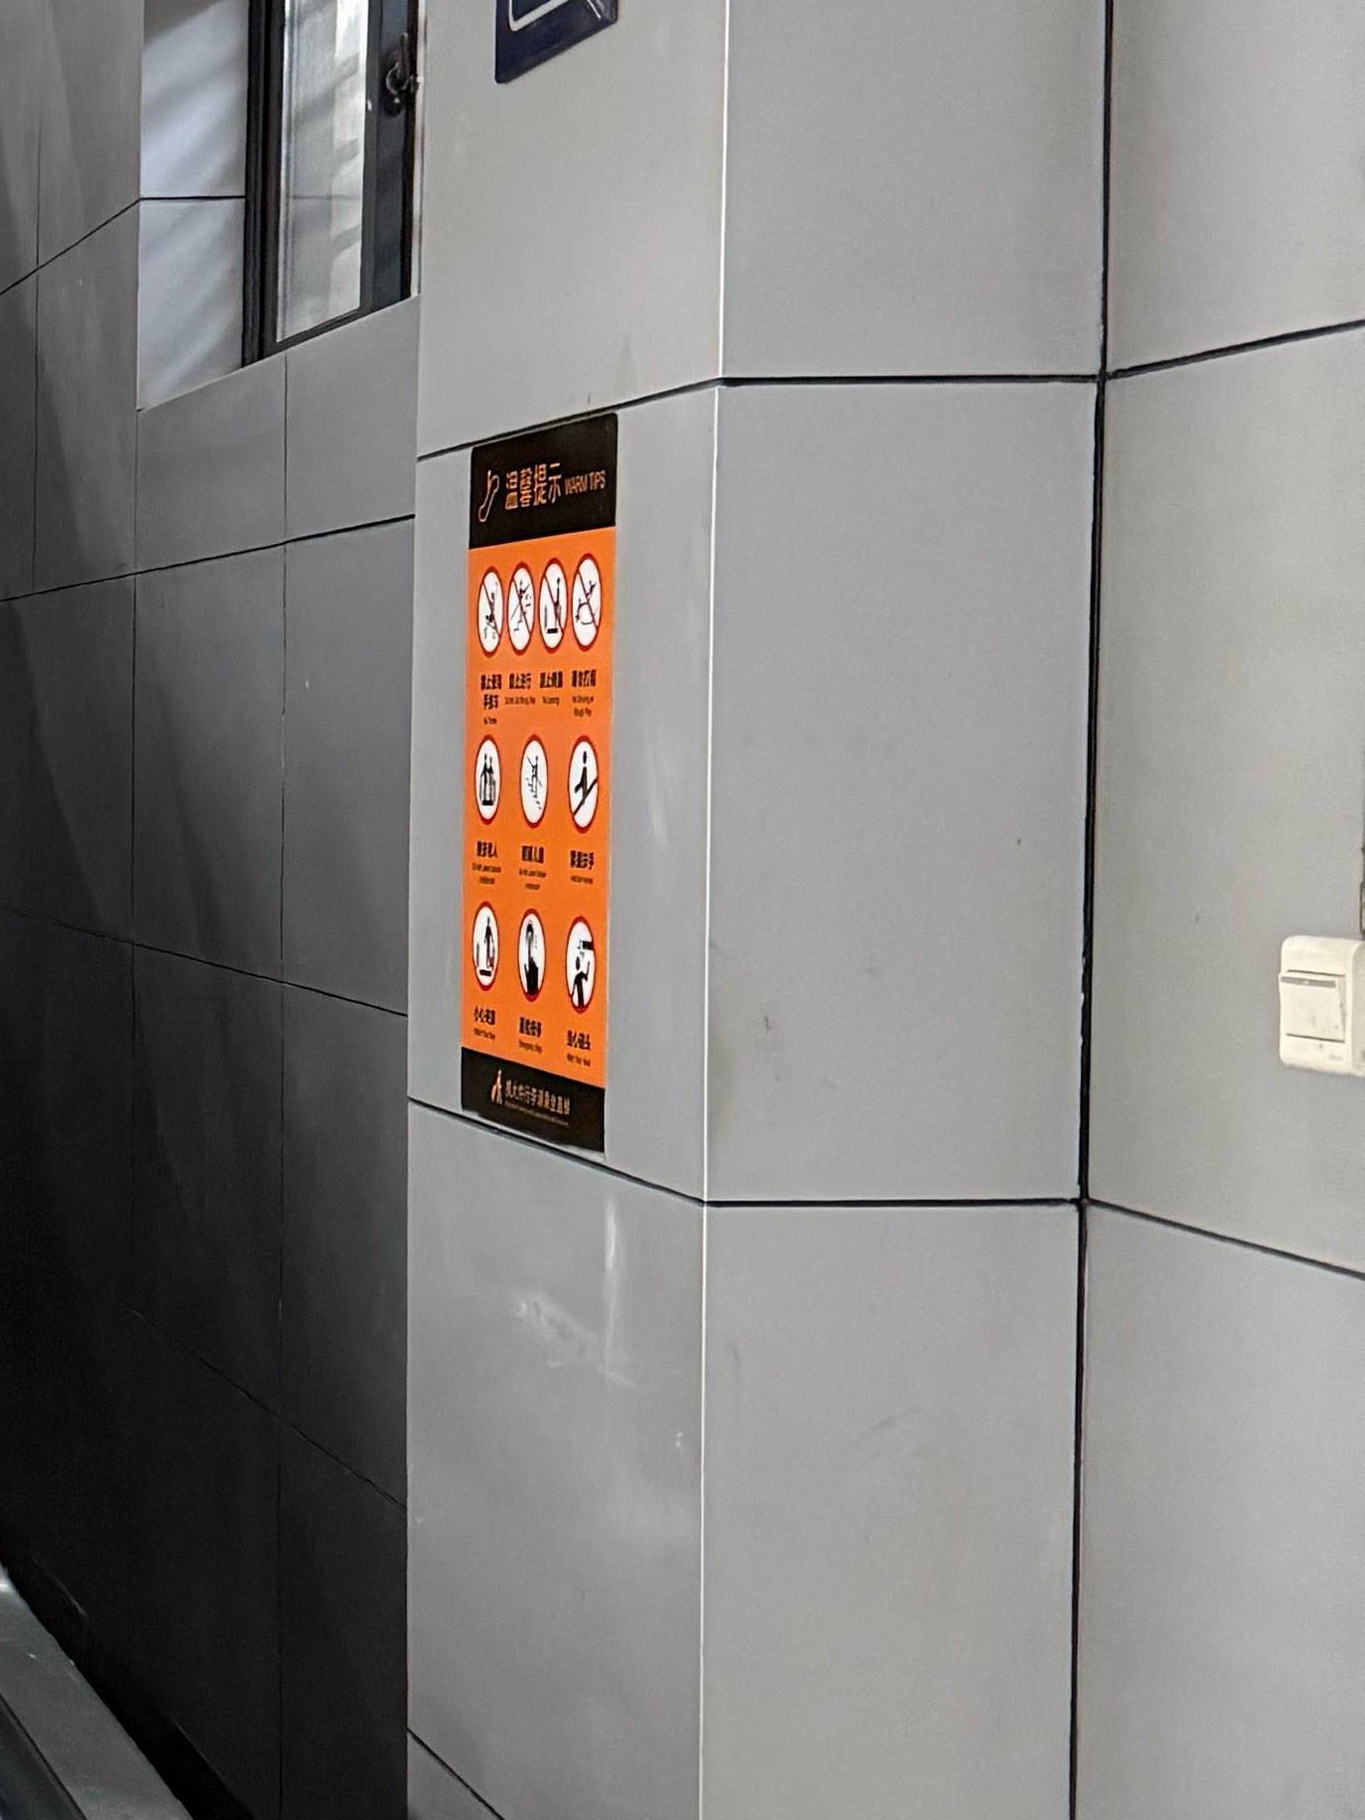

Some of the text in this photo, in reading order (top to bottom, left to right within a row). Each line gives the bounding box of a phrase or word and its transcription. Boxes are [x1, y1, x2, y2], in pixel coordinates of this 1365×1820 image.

[504, 462, 562, 510] 温馨提示
[565, 469, 606, 496] WARM TIPS
